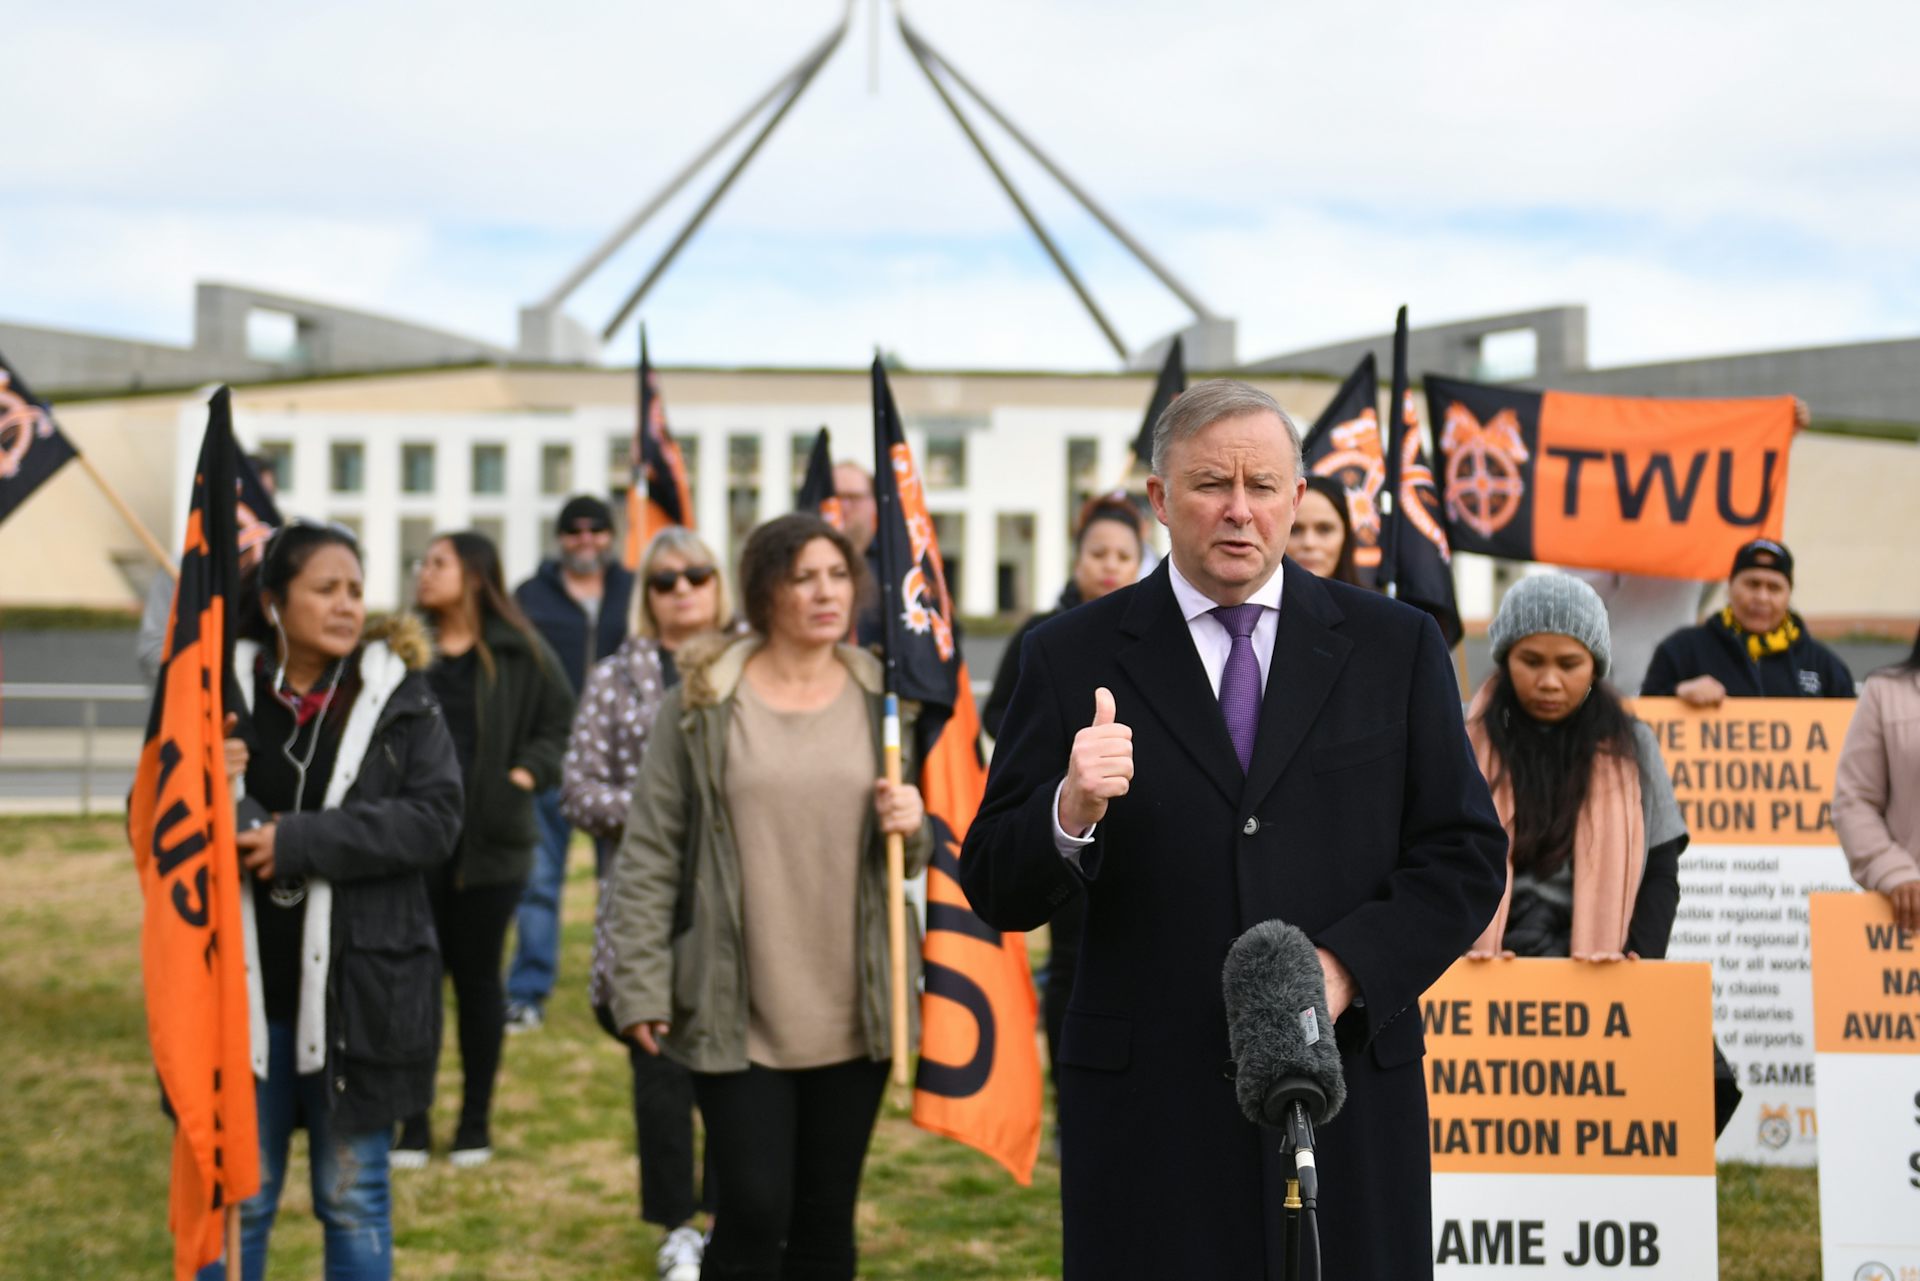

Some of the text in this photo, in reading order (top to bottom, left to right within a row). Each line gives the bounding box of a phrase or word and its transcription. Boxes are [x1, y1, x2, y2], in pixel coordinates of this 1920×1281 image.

[1546, 447, 1777, 528] TWU
[1701, 720, 1791, 751] NEED
[1807, 721, 1828, 752] A
[1672, 759, 1821, 792] ATIONAL
[1771, 801, 1834, 832] PLA
[1733, 857, 1779, 871] model
[1729, 882, 1775, 899] equity
[1782, 881, 1795, 895] in
[1720, 907, 1782, 924] regional
[1717, 931, 1731, 945] of
[1737, 931, 1798, 948] regional
[1721, 957, 1739, 969] for
[1747, 957, 1764, 969] all
[1730, 981, 1780, 995] chains
[1488, 1001, 1590, 1037] NEED
[1604, 1002, 1631, 1037] A
[1734, 1006, 1794, 1021] salaries
[1724, 1031, 1804, 1048] of airports
[1432, 1059, 1626, 1097] NATIONAL
[1749, 1062, 1815, 1086] SAME
[1429, 1118, 1678, 1157] IATION PLAN
[1436, 1219, 1660, 1267] AME JOB
